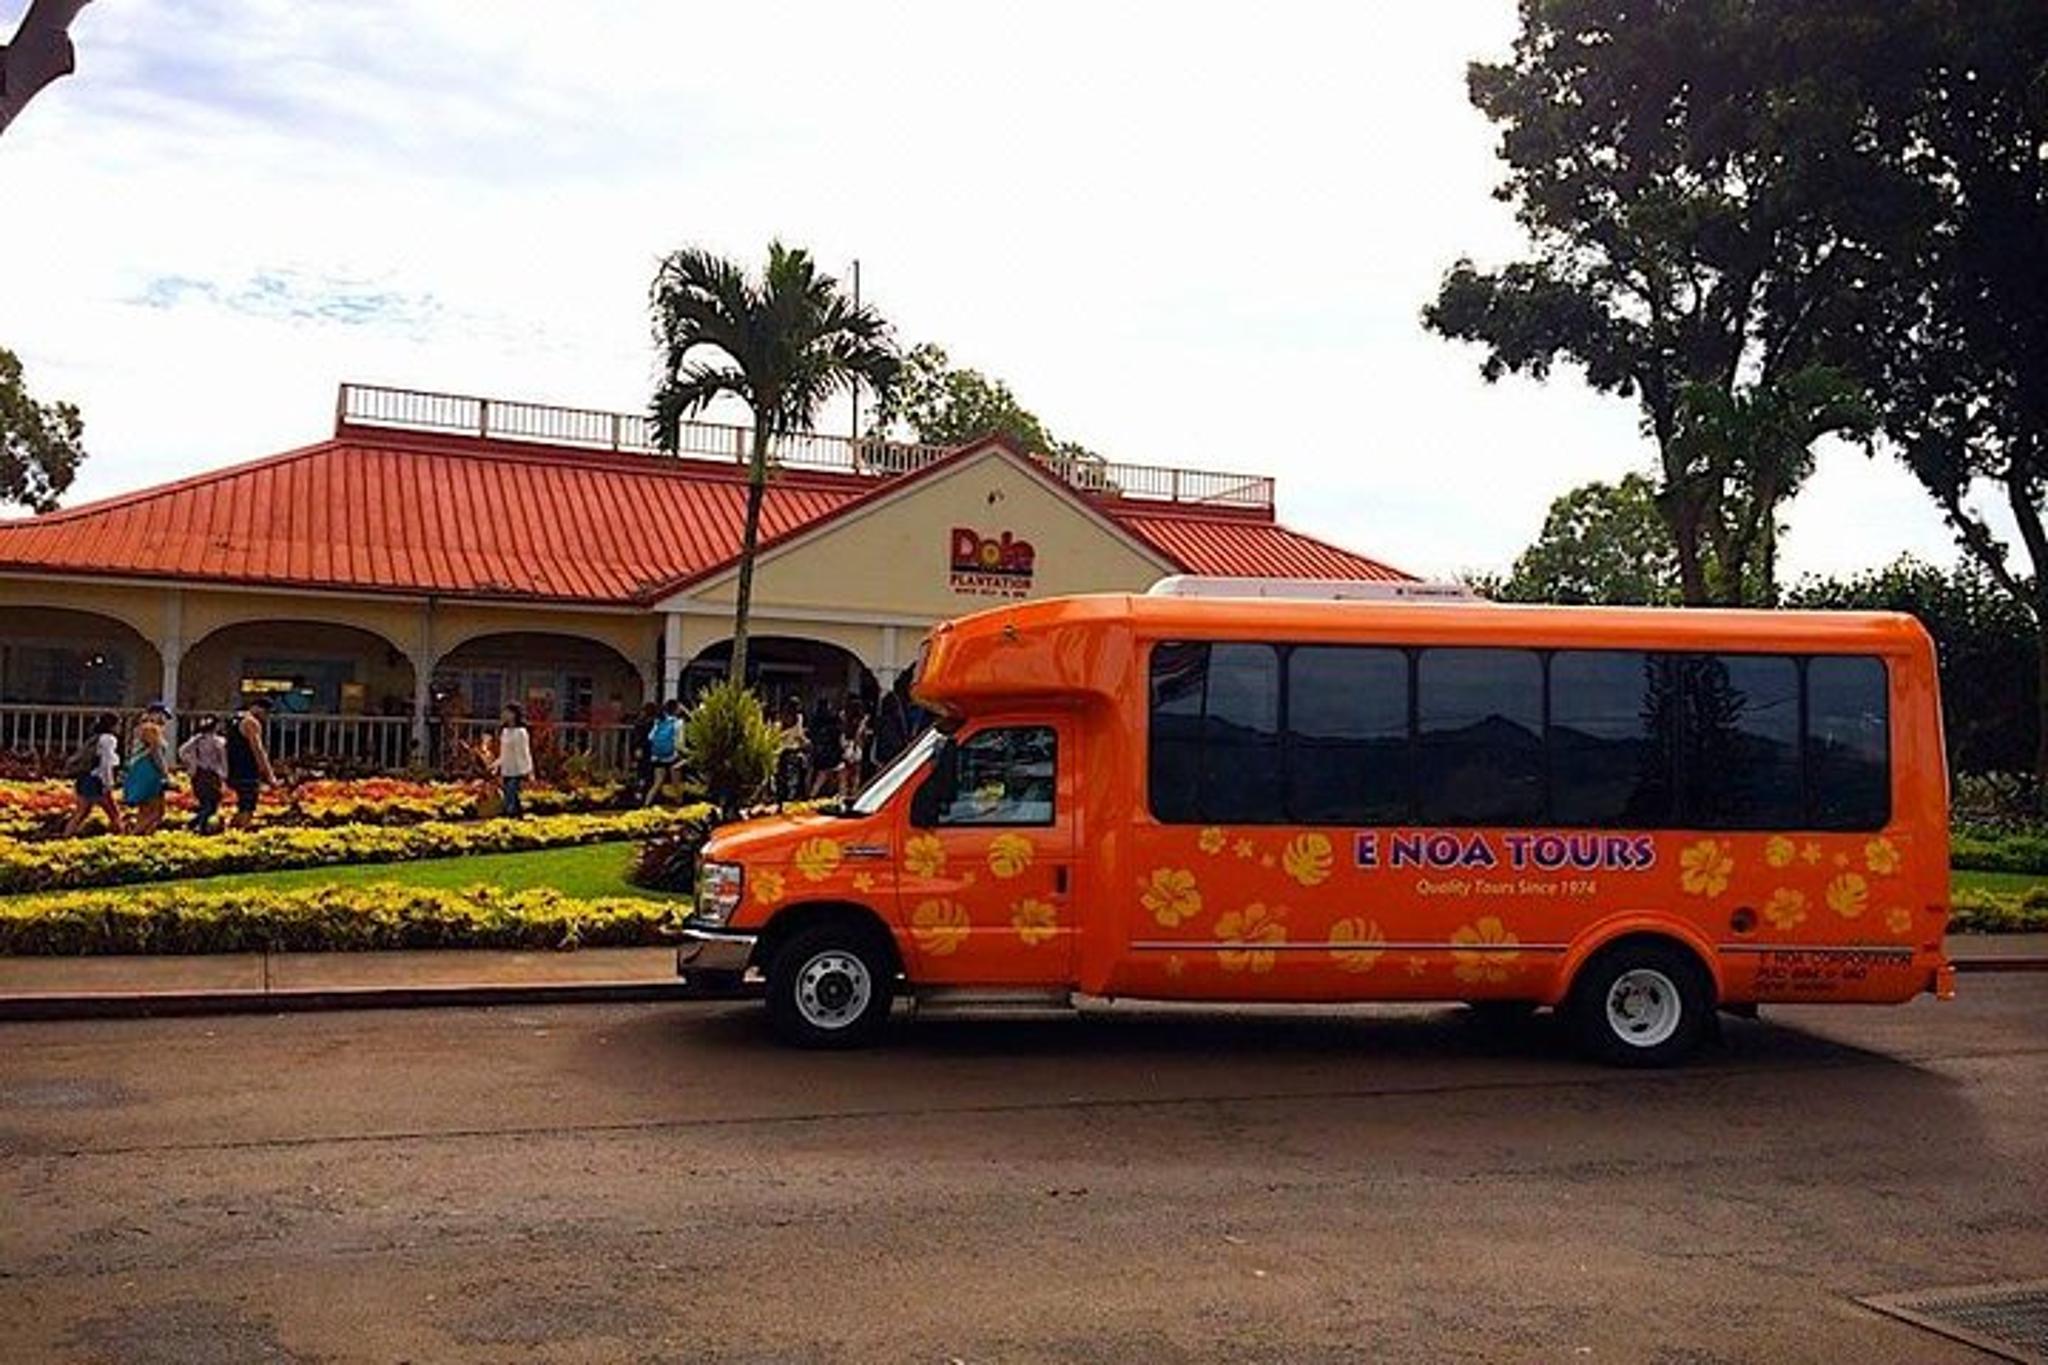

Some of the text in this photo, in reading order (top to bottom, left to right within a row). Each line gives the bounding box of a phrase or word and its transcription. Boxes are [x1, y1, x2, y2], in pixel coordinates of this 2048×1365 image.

[952, 528, 1035, 572] Dole
[950, 574, 1032, 589] PLANTATION
[1356, 832, 1657, 871] E NOA TOURS
[1416, 878, 1597, 896] Quality Tours Since 1974
